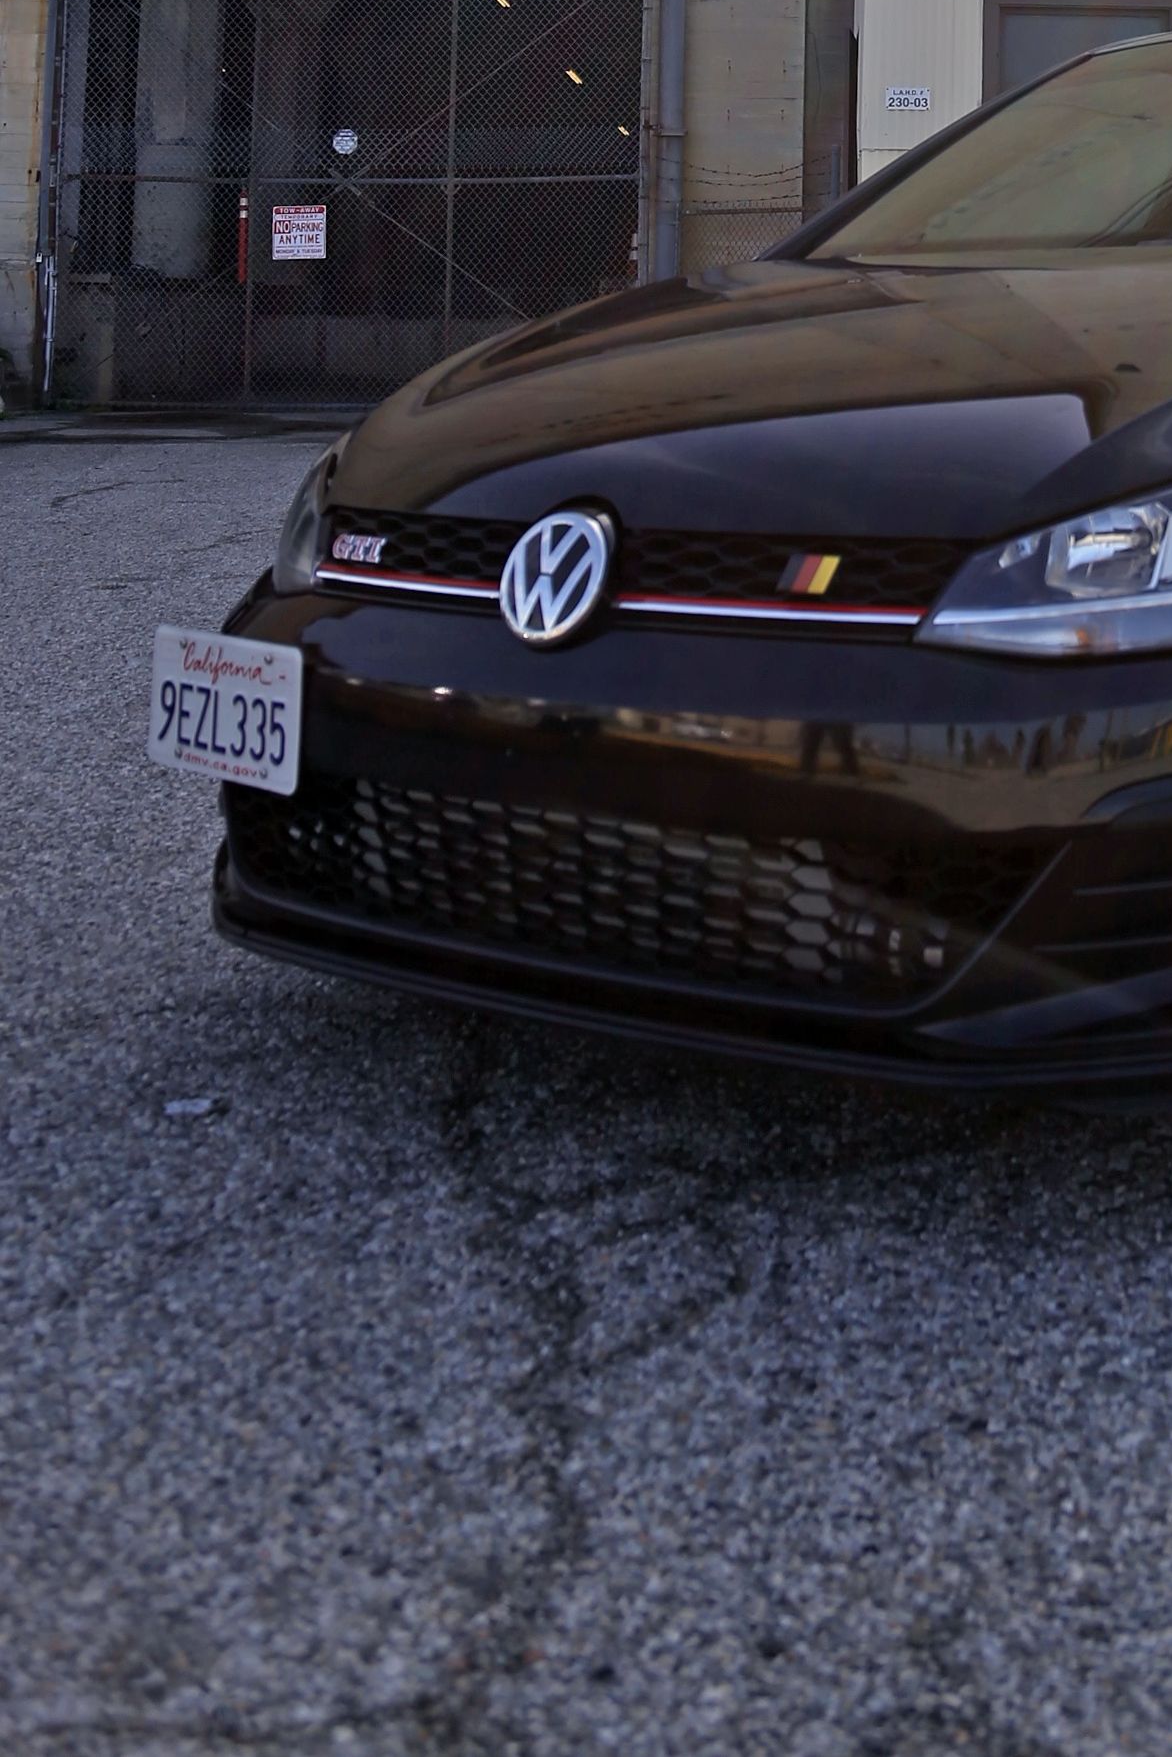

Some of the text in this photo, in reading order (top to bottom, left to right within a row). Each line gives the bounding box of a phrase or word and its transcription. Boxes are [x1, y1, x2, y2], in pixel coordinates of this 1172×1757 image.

[888, 97, 928, 107] 230-03
[280, 206, 319, 214] TOW-AWAY
[276, 221, 324, 233] NO PARKING
[279, 234, 320, 244] ANYTIME
[332, 533, 386, 564] GTI
[183, 641, 272, 685] California
[158, 680, 286, 767] 9EZL335
[183, 752, 257, 778] dmv.ca.gov
